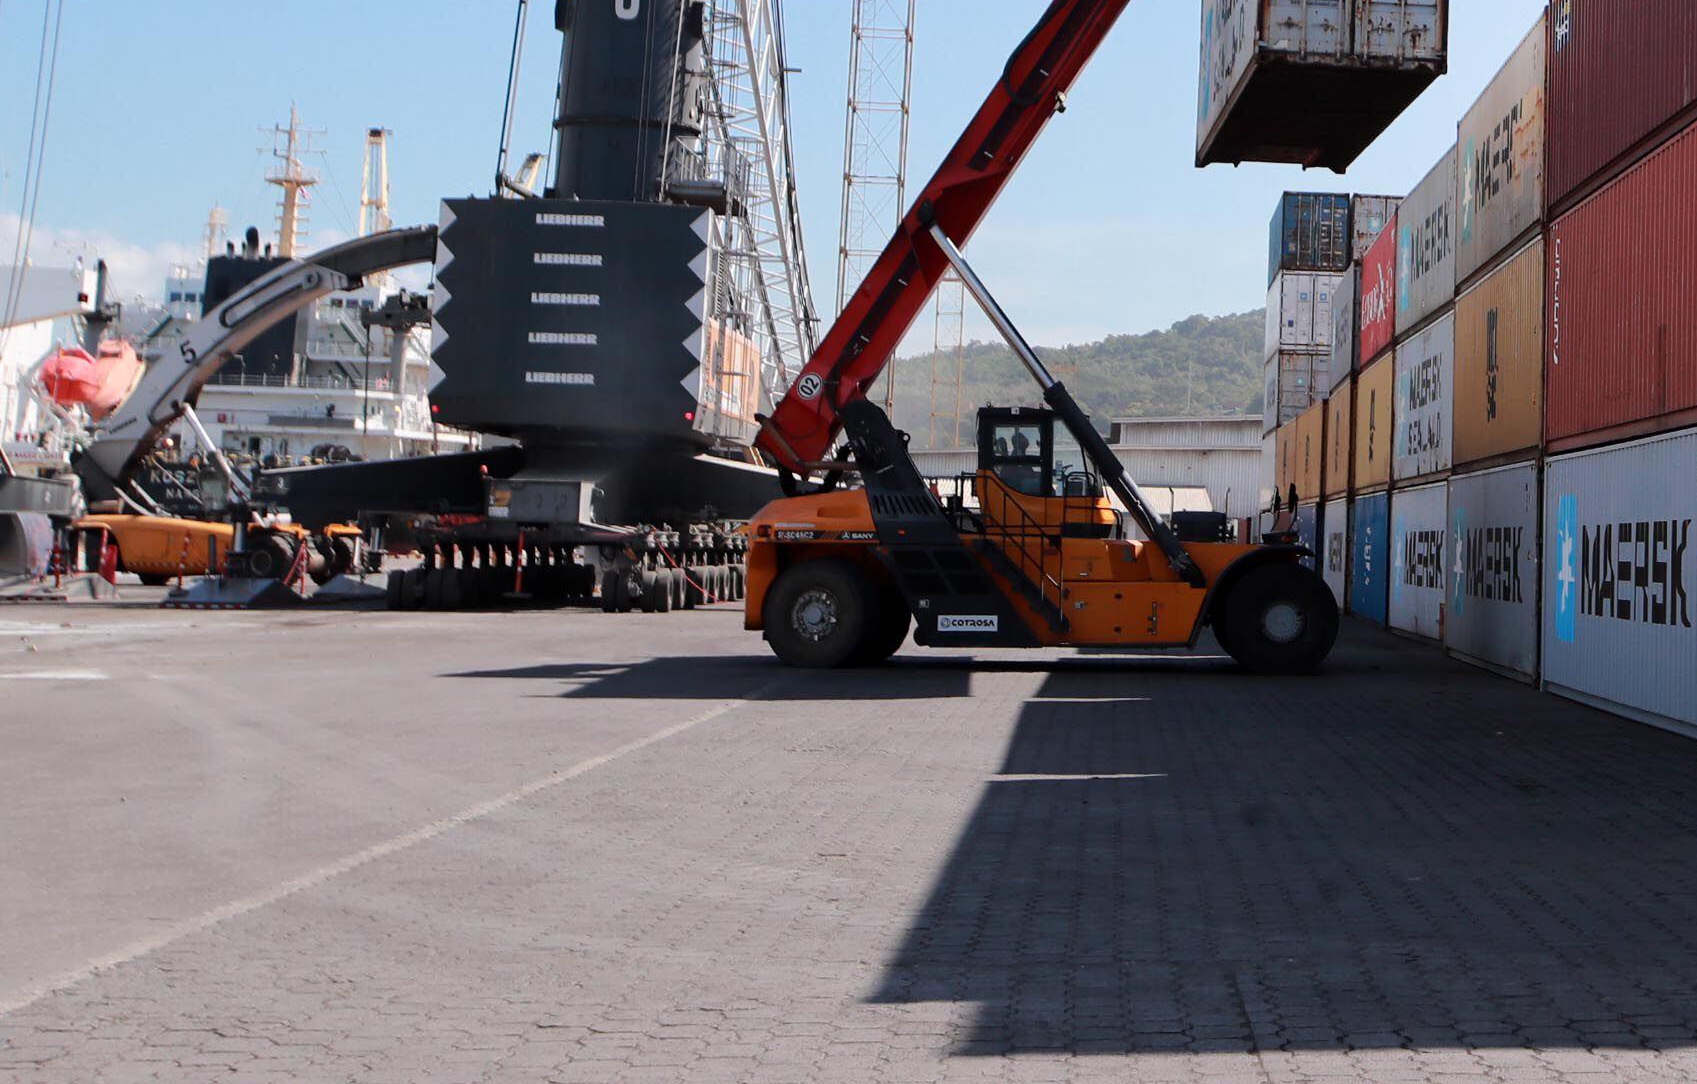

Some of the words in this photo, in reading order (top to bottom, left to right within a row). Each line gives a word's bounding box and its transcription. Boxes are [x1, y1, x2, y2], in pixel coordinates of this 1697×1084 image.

[536, 213, 605, 227] LIEBHERR
[534, 252, 603, 266] LIEBHERR
[531, 292, 600, 305] LIEBHERR
[528, 332, 597, 345] LIEBHERR
[180, 340, 197, 364] 5
[525, 371, 594, 385] LIEBHERR
[800, 376, 821, 397] 02
[851, 532, 874, 540] SANY
[1404, 530, 1445, 589] MAERSK
[1466, 527, 1523, 604] MAERSK
[1581, 519, 1692, 628] MAERSK
[951, 619, 995, 627] COTROSA
